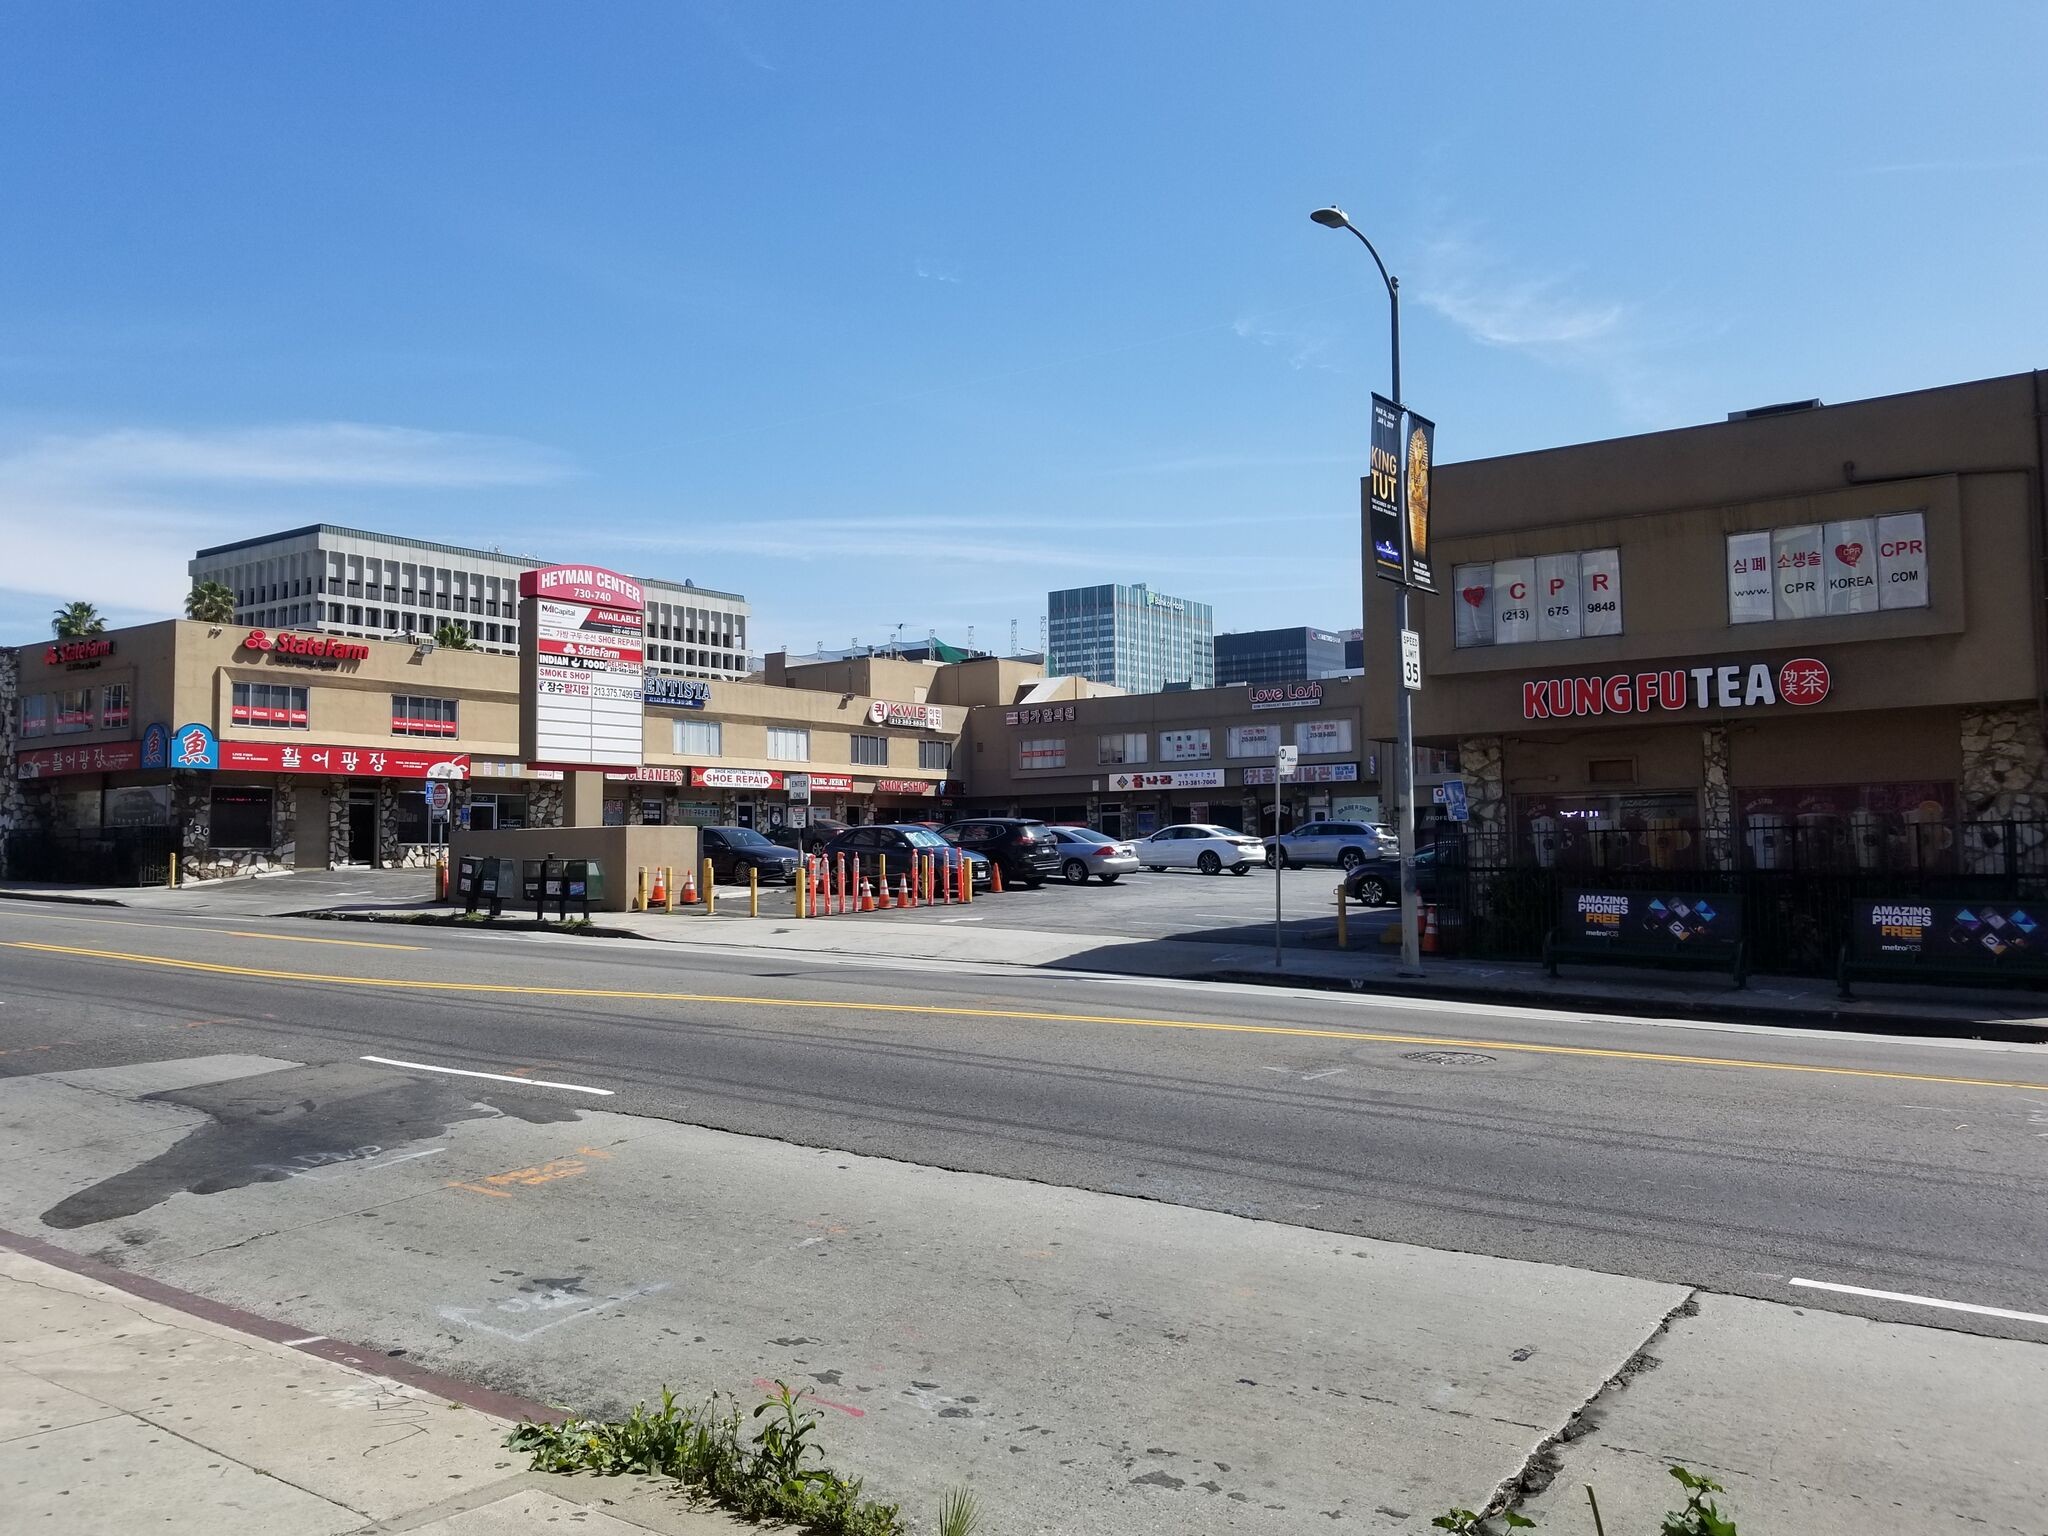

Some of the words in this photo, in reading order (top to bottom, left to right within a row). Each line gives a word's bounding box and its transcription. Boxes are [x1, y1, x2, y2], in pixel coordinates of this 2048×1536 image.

[1371, 446, 1397, 475] KING
[1371, 469, 1397, 503] TUT
[1843, 547, 1861, 556] CPR
[1881, 540, 1923, 557] CPR
[1777, 551, 1821, 569] 소생술
[1830, 576, 1874, 590] KOREA
[1888, 570, 1918, 584] .COM
[541, 569, 593, 589] HEYMAN
[596, 572, 641, 603] CENTER
[1784, 581, 1816, 594] CPR
[1734, 588, 1770, 597] www.
[598, 611, 641, 625] AVAILABLE
[1502, 609, 1529, 623] (213)
[1547, 606, 1569, 617] 675
[1587, 601, 1616, 613] 9848
[598, 635, 616, 645] SHOE
[617, 637, 641, 647] REPAIR
[1403, 635, 1418, 647] SPEED
[539, 654, 569, 666] INDIAN
[1405, 649, 1417, 659] LIMIT
[539, 668, 568, 678] SMOKE
[569, 671, 591, 680] SHOP
[1406, 662, 1419, 683] 35
[593, 686, 633, 699] 213.375.7499
[644, 677, 712, 700] ENTISTA
[1248, 687, 1284, 703] Love
[1287, 681, 1323, 700] Lash
[252, 709, 267, 717] Home
[179, 730, 211, 764] 魚
[706, 773, 732, 783] SHOE
[736, 775, 769, 785] REPAIR
[811, 777, 828, 785] KING
[828, 778, 847, 787] JERKY
[880, 780, 907, 792] SMOKE
[908, 782, 929, 793] SHOP
[1359, 804, 1372, 814] SHOP
[1578, 894, 1629, 905] AMAZING
[1578, 903, 1629, 915] PHONES
[1872, 905, 1932, 916] AMAZING
[1586, 913, 1620, 924] FREE
[1872, 915, 1932, 927] PHONES
[1881, 926, 1922, 938] FREE
[1881, 944, 1921, 952] metroPCS
